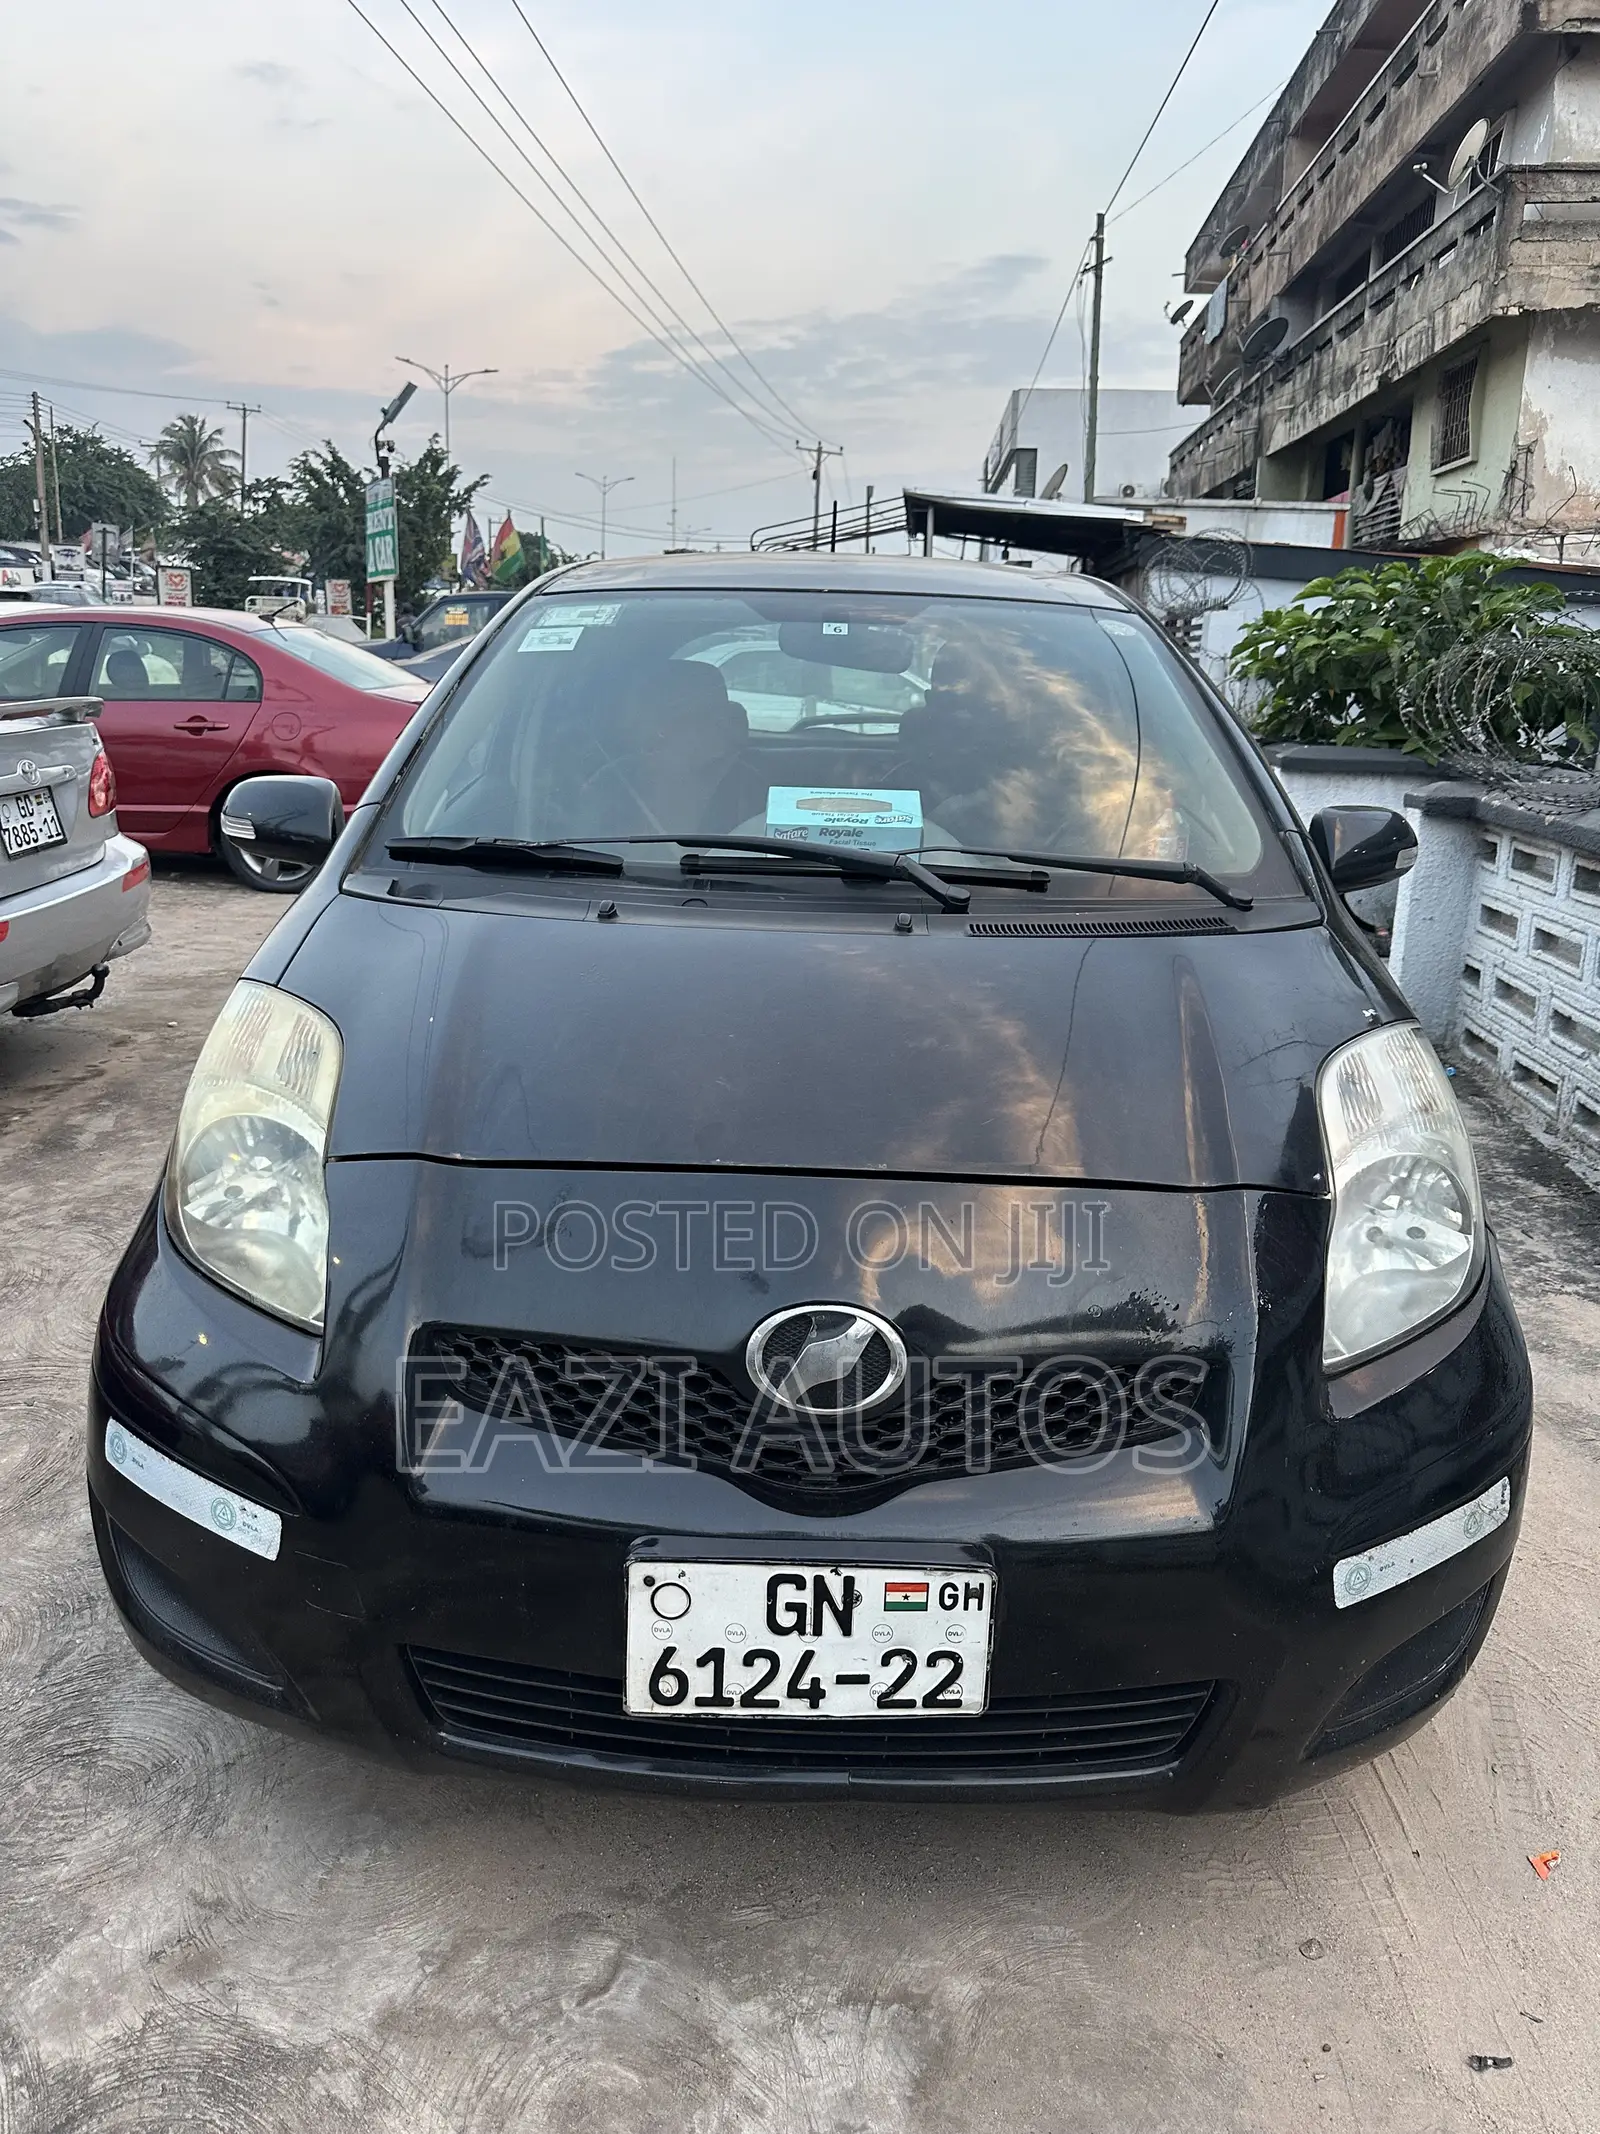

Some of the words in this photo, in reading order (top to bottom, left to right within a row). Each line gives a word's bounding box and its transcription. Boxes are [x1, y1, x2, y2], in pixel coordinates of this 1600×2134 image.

[15, 794, 34, 818] GC
[819, 827, 864, 838] Royale
[766, 1573, 855, 1637] GN
[939, 1582, 984, 1611] GH
[649, 1646, 964, 1709] 6124-22
